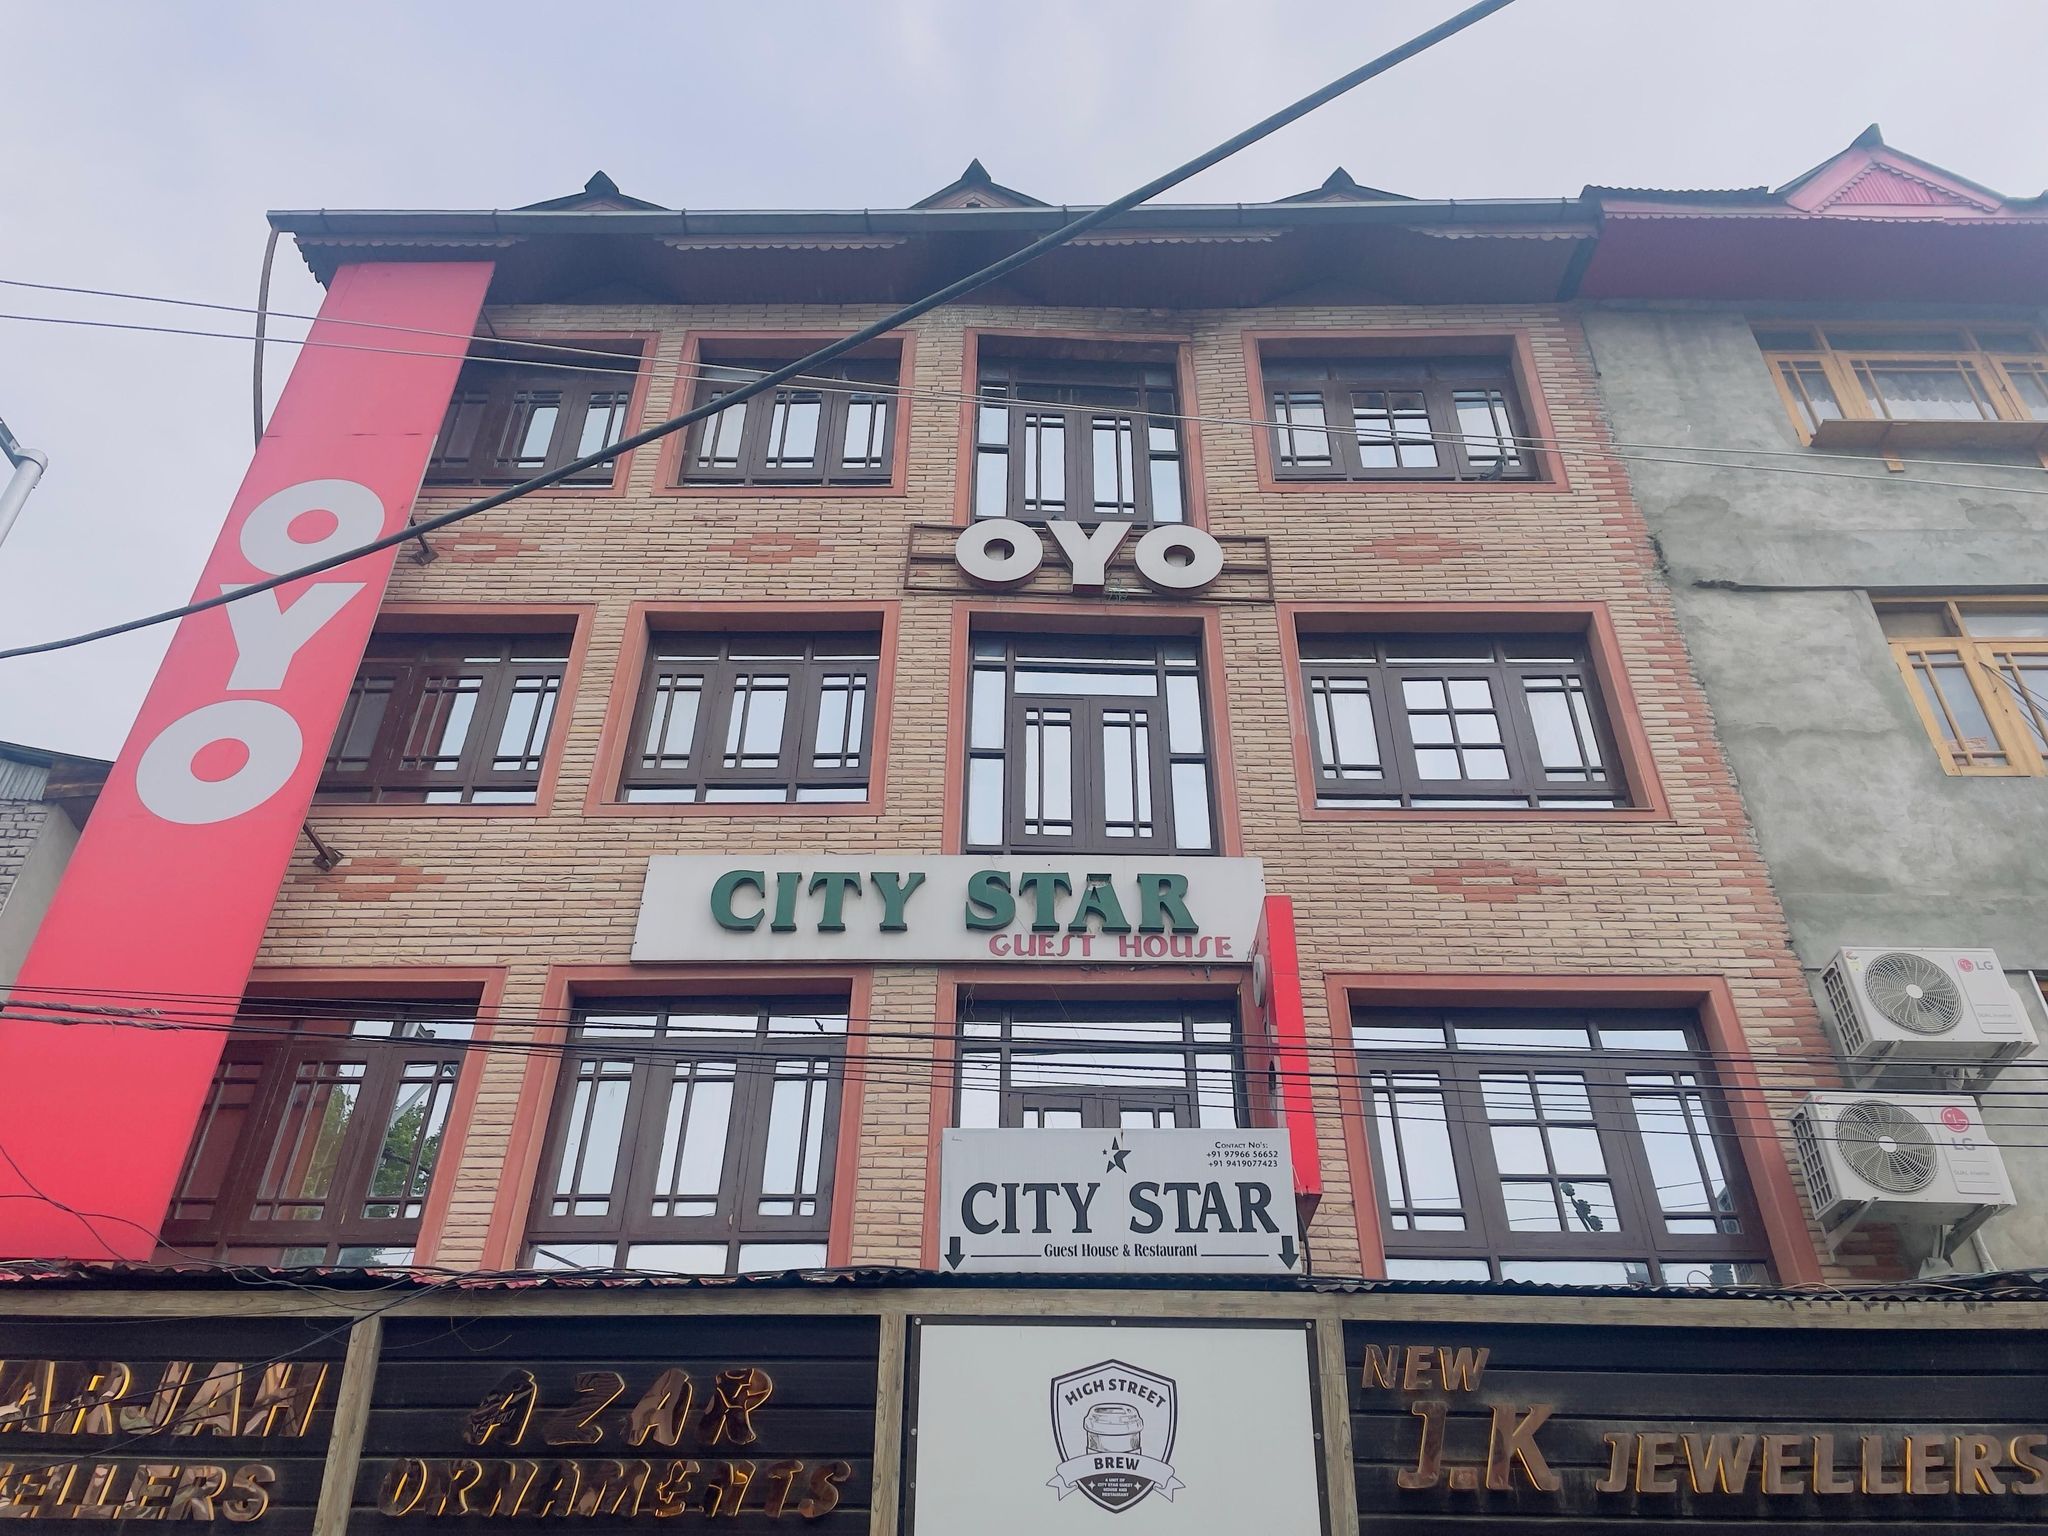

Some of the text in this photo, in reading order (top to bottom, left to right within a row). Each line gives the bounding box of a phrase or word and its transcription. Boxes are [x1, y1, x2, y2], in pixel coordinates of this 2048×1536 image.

[955, 518, 1225, 595] OYO
[135, 479, 385, 824] OYO
[710, 869, 1199, 933] CITY STAR
[989, 934, 1233, 958] GUEST HOUSE
[1206, 1150, 1279, 1158] +91 97966 56652
[1208, 1160, 1278, 1168] +91 9419077423
[1951, 1137, 1976, 1151] LG
[961, 1181, 1280, 1235] CITY STAR
[1044, 1243, 1198, 1258] Guest House & Restaurant
[1065, 1378, 1167, 1408] HIGH STREET
[1361, 1343, 1490, 1392] NEW
[0, 1360, 328, 1437] ARJAH
[462, 1368, 773, 1447] AZAR
[377, 1457, 852, 1520] ORNAMENTS
[1093, 1456, 1140, 1471] BREW
[1596, 1432, 2048, 1495] JEWELLERS
[0, 1464, 276, 1522] ELLERS
